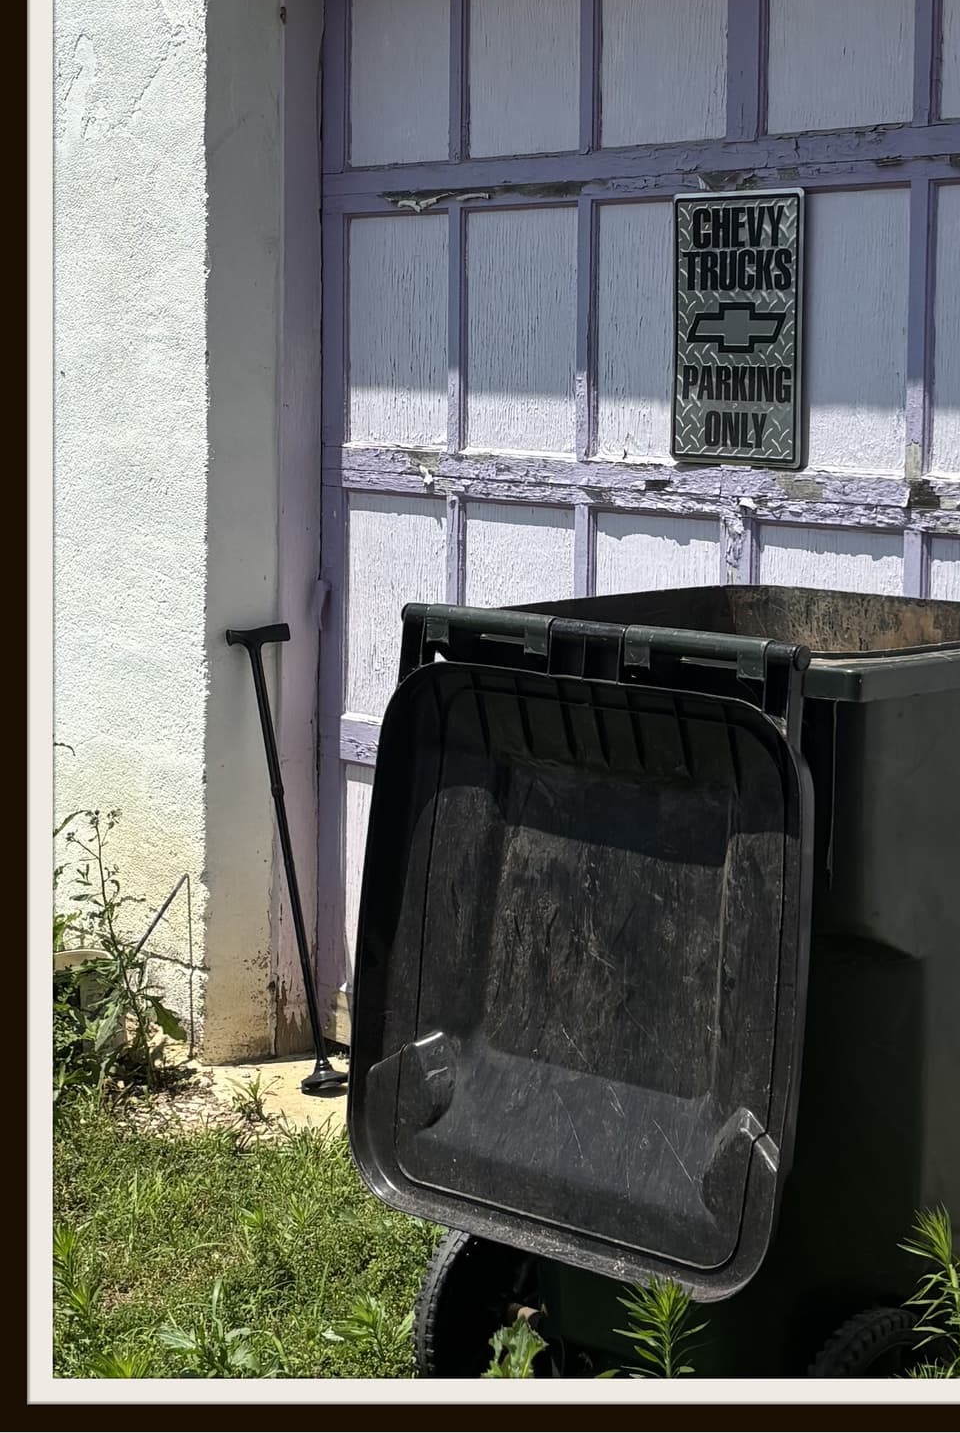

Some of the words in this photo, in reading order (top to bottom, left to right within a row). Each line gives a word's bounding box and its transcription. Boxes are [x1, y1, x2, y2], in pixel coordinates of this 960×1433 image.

[692, 205, 785, 249] CHEVY
[683, 247, 793, 291] TRUCKS
[682, 364, 792, 404] PARKING
[704, 410, 768, 449] ONLY
